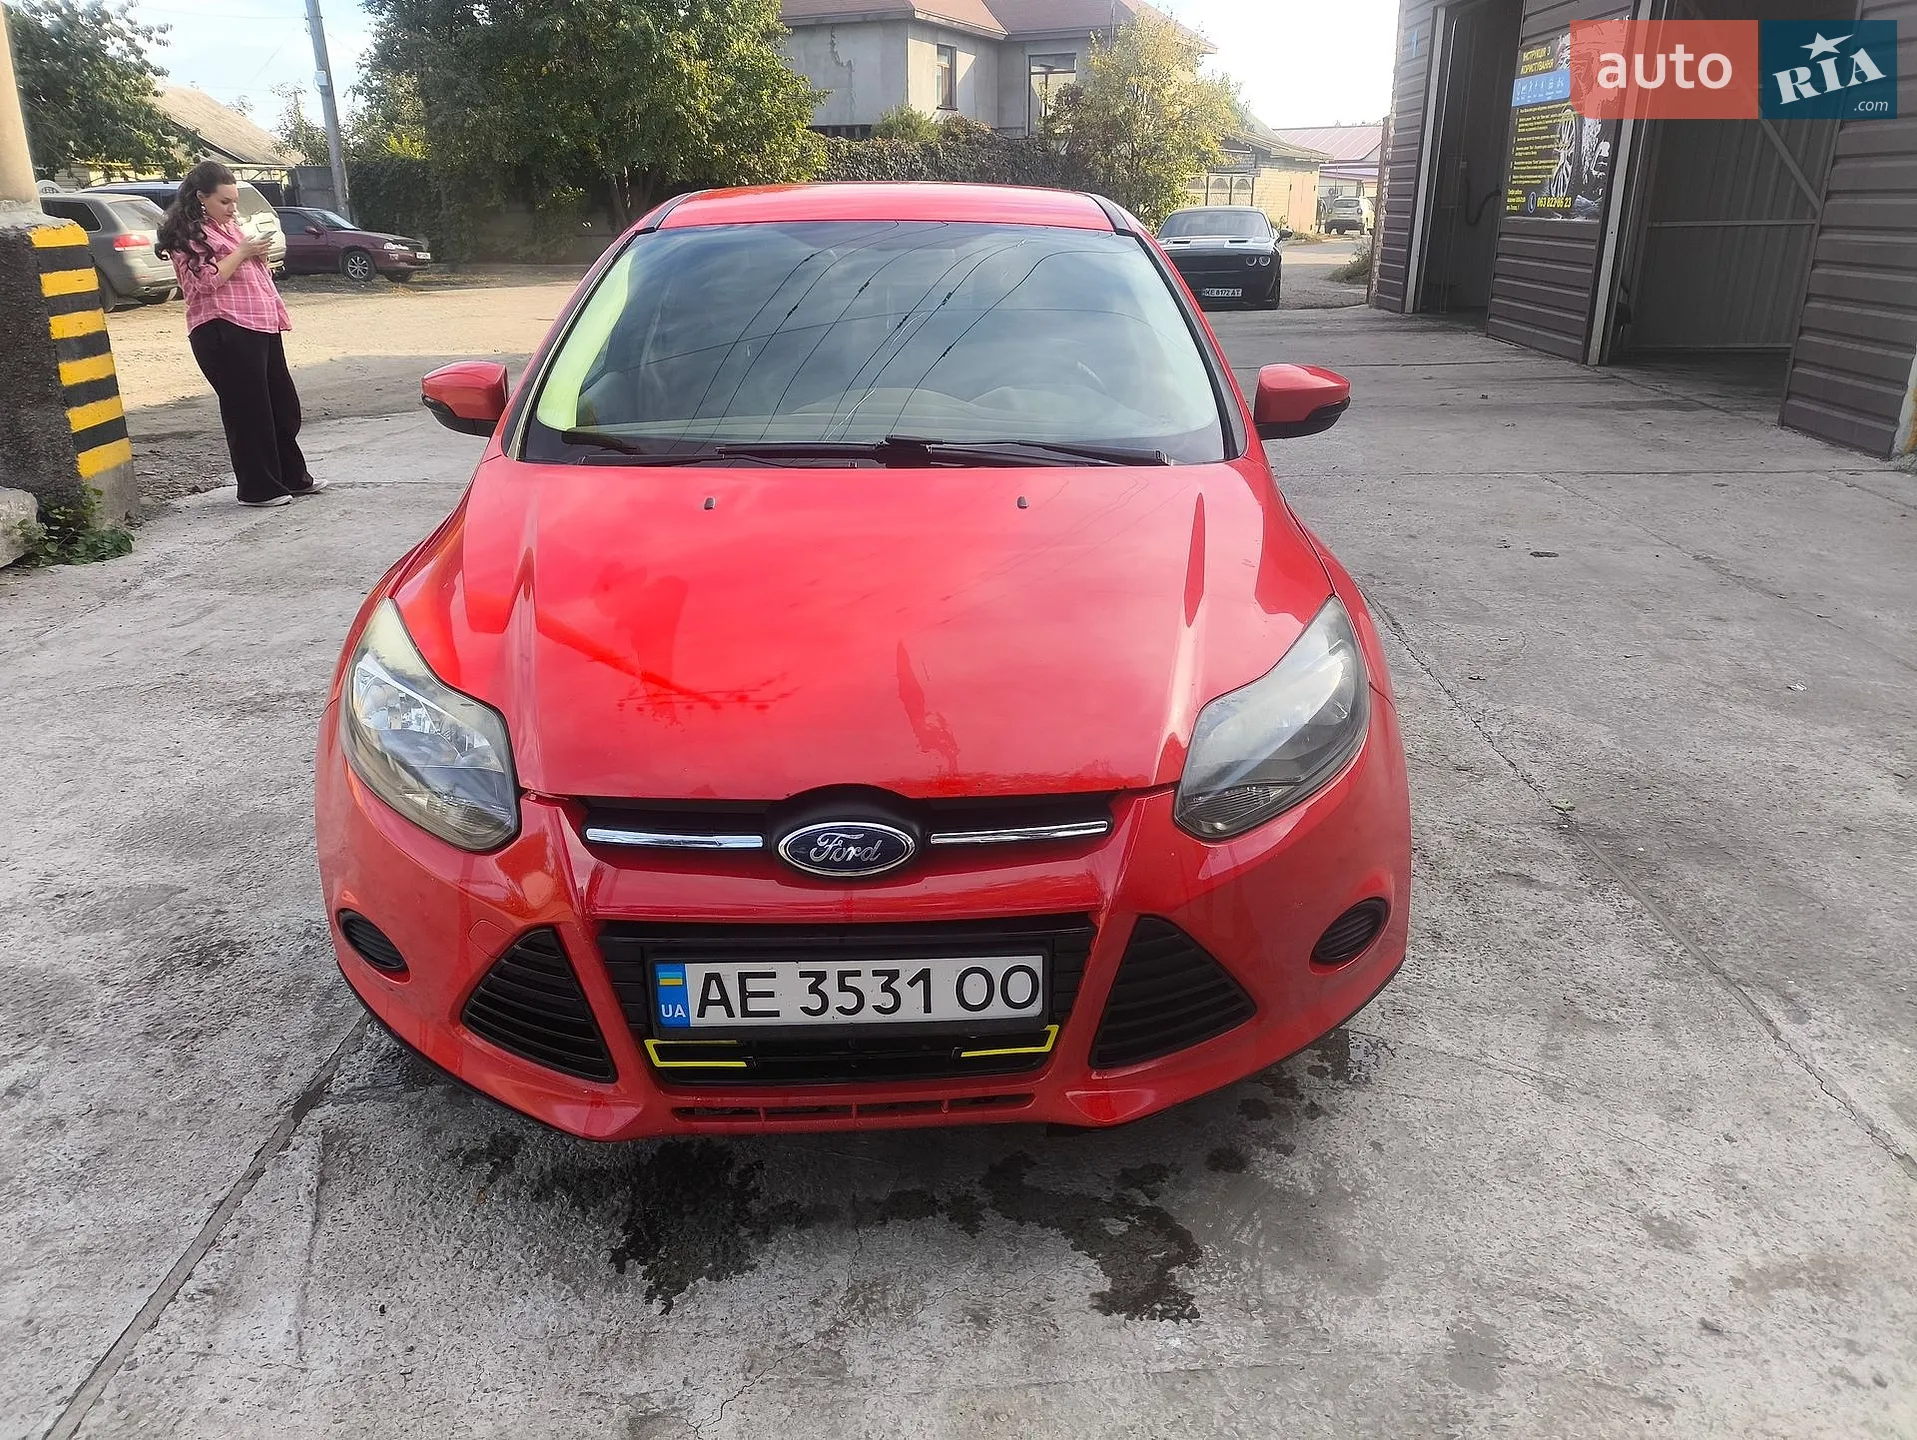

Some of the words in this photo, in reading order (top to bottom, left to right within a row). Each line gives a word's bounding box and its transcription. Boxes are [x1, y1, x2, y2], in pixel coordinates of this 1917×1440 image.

[809, 832, 883, 862] Ford
[696, 971, 781, 1019] AE
[798, 967, 932, 1016] 3531
[661, 1004, 686, 1018] UA
